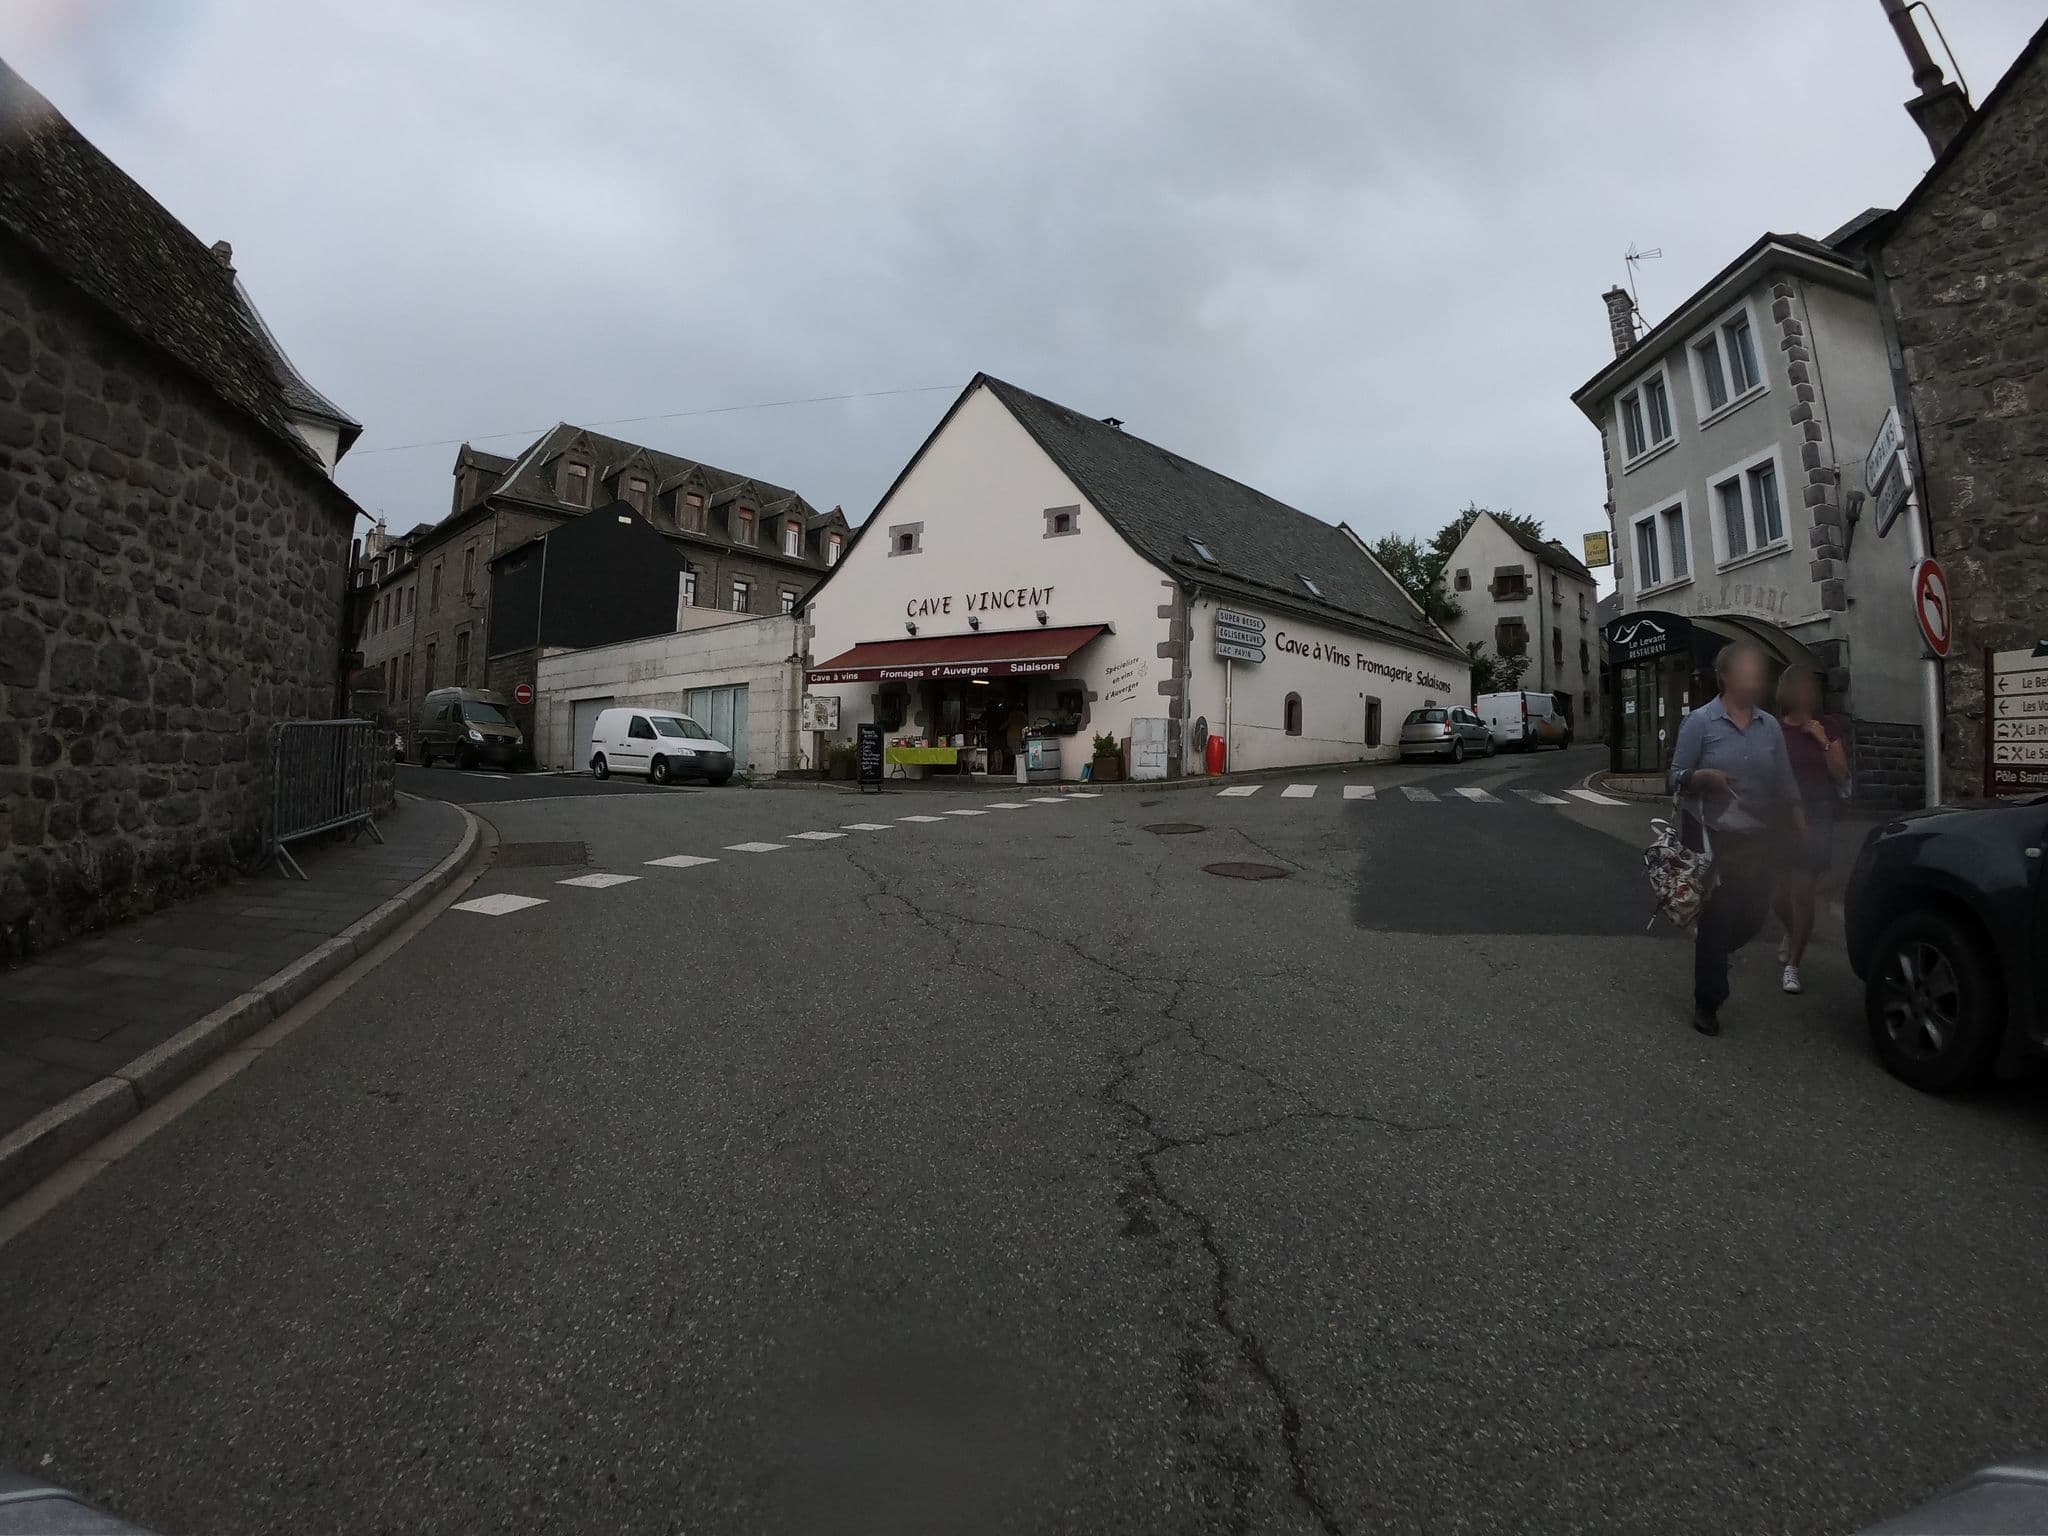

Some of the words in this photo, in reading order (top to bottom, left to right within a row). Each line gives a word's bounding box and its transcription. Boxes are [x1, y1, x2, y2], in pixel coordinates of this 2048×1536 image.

[907, 596, 952, 617] CAVE
[966, 586, 1055, 611] VINCENT
[1220, 612, 1240, 623] SUPER
[1242, 617, 1260, 628] BESSE
[1629, 640, 1638, 649] Le
[1640, 634, 1666, 646] Levant
[1220, 645, 1232, 655] LAC
[1629, 644, 1666, 659] RESTAURANT
[1105, 656, 1139, 675] Spécialiste
[1275, 631, 1309, 657] Cave
[1313, 642, 1321, 661] à
[1325, 643, 1351, 667] Vins
[1357, 653, 1413, 682] Fromagerie
[1417, 671, 1451, 693] Salaisons
[811, 674, 831, 683] Cave
[833, 673, 838, 682] à
[842, 672, 858, 681] vins
[880, 669, 924, 679] Fromages
[942, 666, 989, 676] Auvergne
[1010, 662, 1060, 673] Salaisons
[2022, 678, 2033, 688] Le
[2036, 676, 2048, 688] Be
[1105, 681, 1139, 700] d'Auvergne
[2023, 701, 2036, 712] Les
[2026, 724, 2036, 735] La
[2026, 747, 2036, 759] Le
[1995, 769, 2017, 783] Pôle
